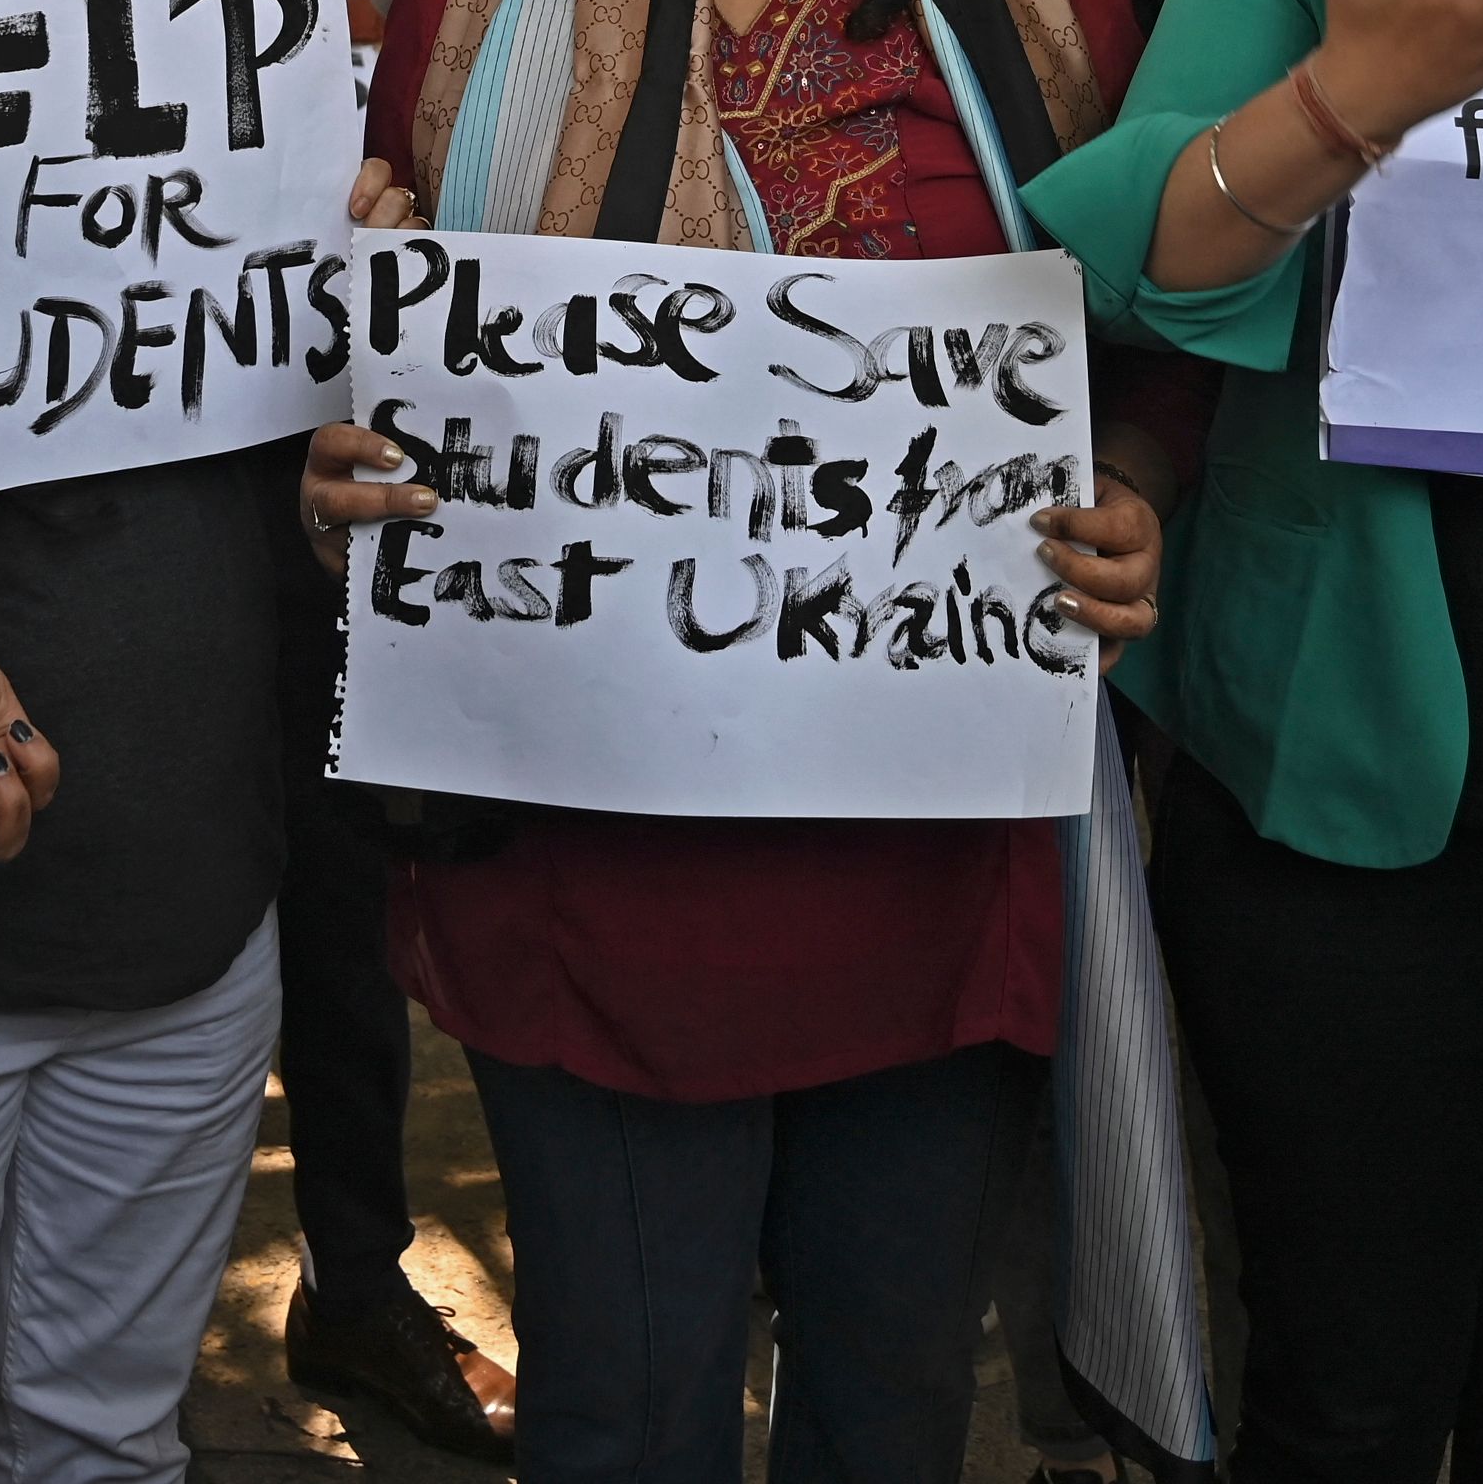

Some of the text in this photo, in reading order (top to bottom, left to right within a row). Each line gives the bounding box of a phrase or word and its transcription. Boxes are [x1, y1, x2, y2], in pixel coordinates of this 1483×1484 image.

[14, 153, 237, 267] FOR
[369, 236, 738, 383] Please
[370, 518, 635, 629] East
